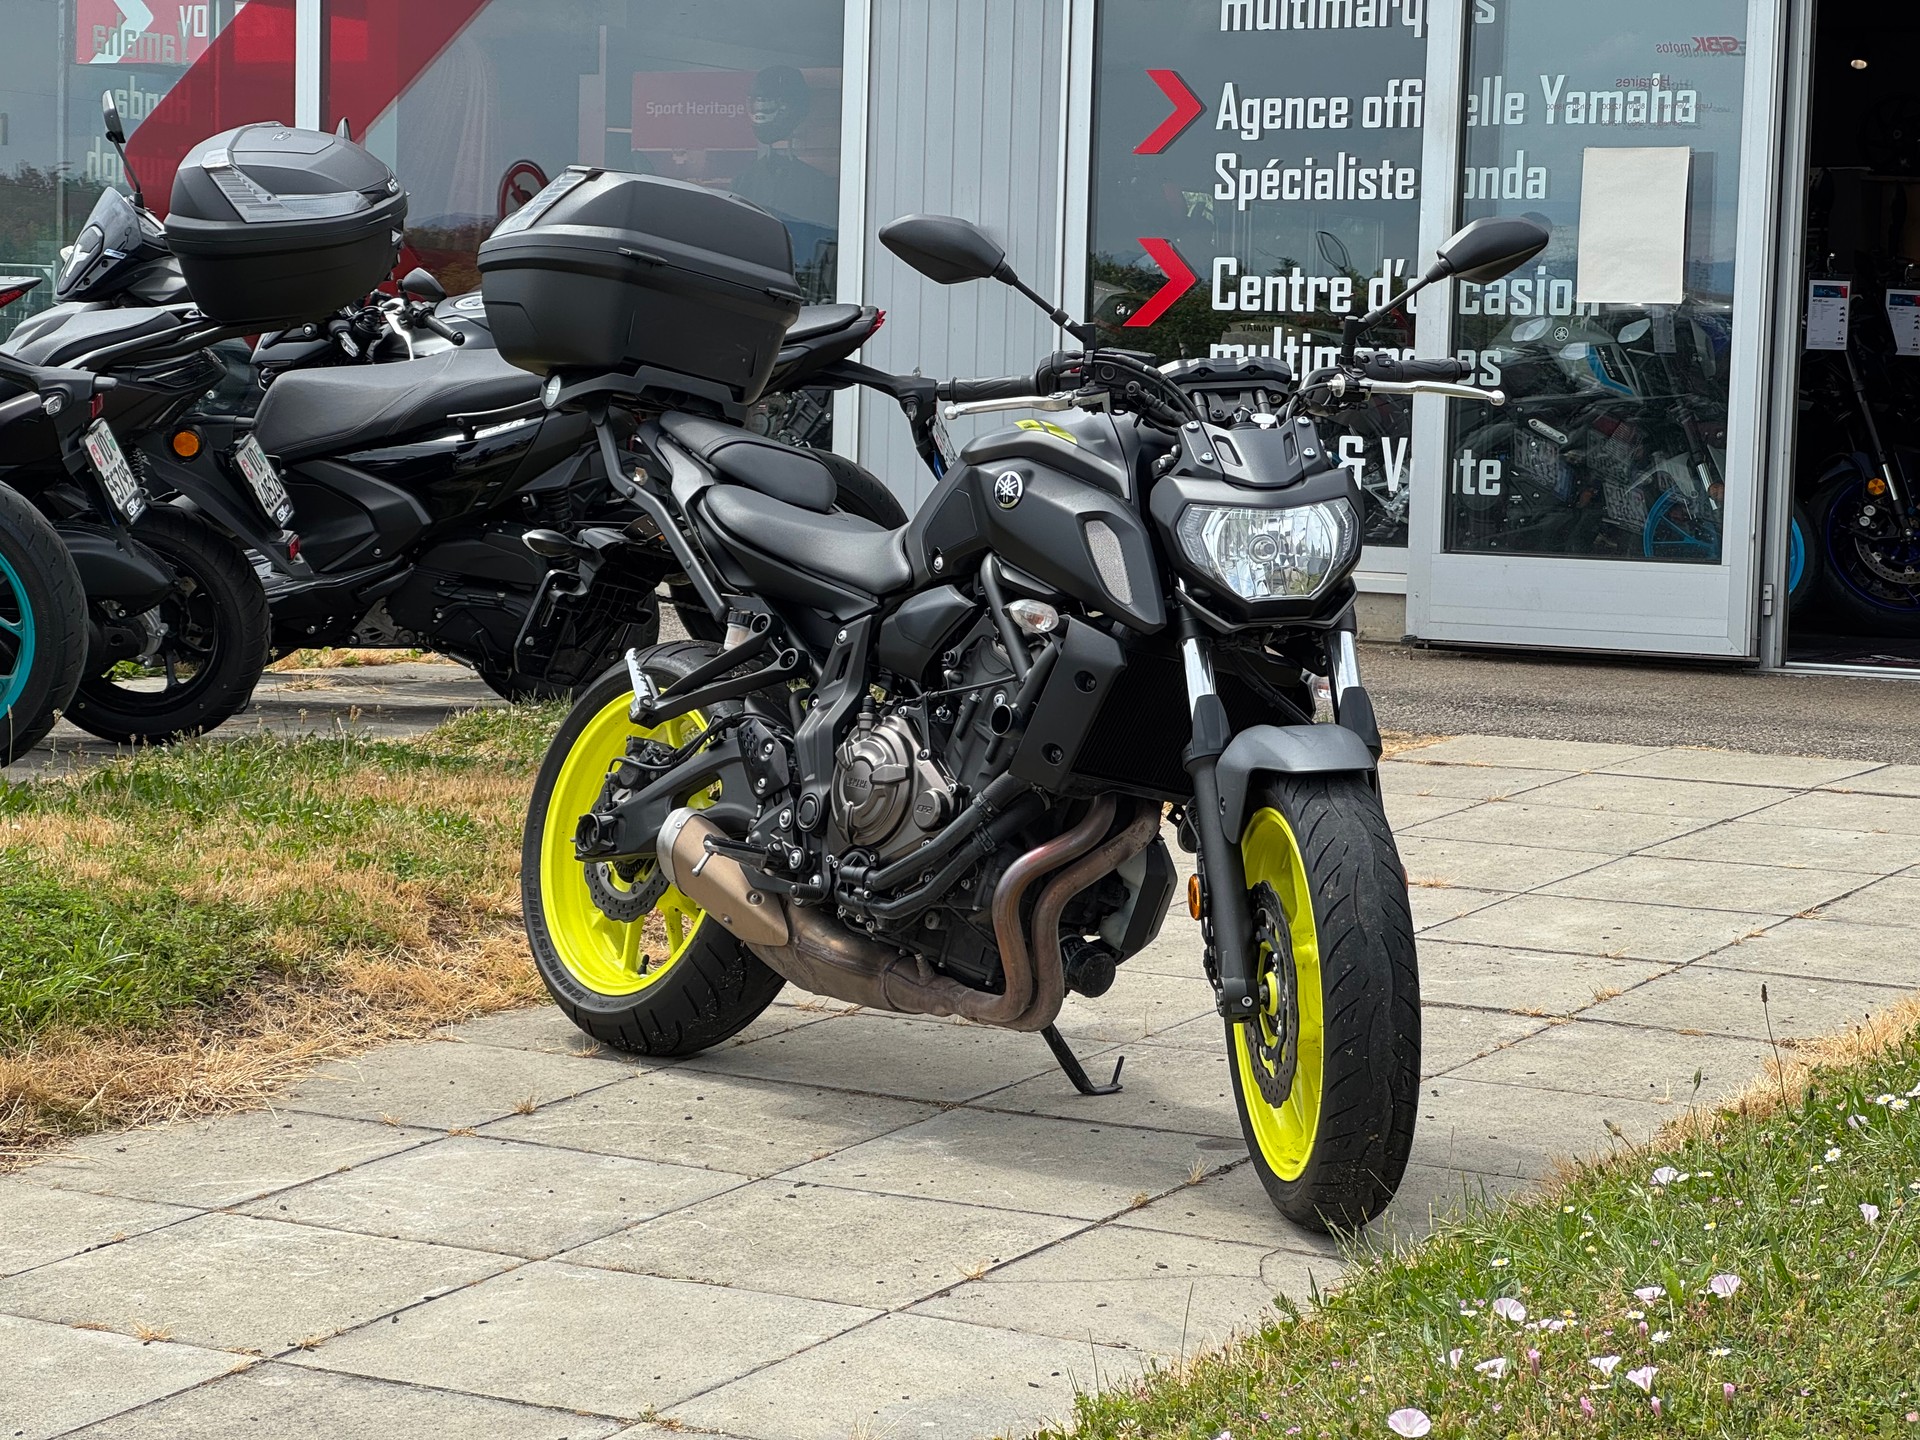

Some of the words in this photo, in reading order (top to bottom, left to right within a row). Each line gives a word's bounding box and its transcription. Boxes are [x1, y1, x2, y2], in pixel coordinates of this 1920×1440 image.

[646, 102, 684, 118] Sport
[686, 102, 745, 118] Heritage
[1215, 82, 1348, 141] Agence
[1540, 72, 1697, 126] Yamaha
[1214, 152, 1415, 211] Spécialiste
[1464, 150, 1547, 199] onda
[1212, 257, 1352, 312] Centre
[94, 431, 113, 465] VD
[244, 447, 263, 476] VD
[1381, 437, 1501, 496] Vte
